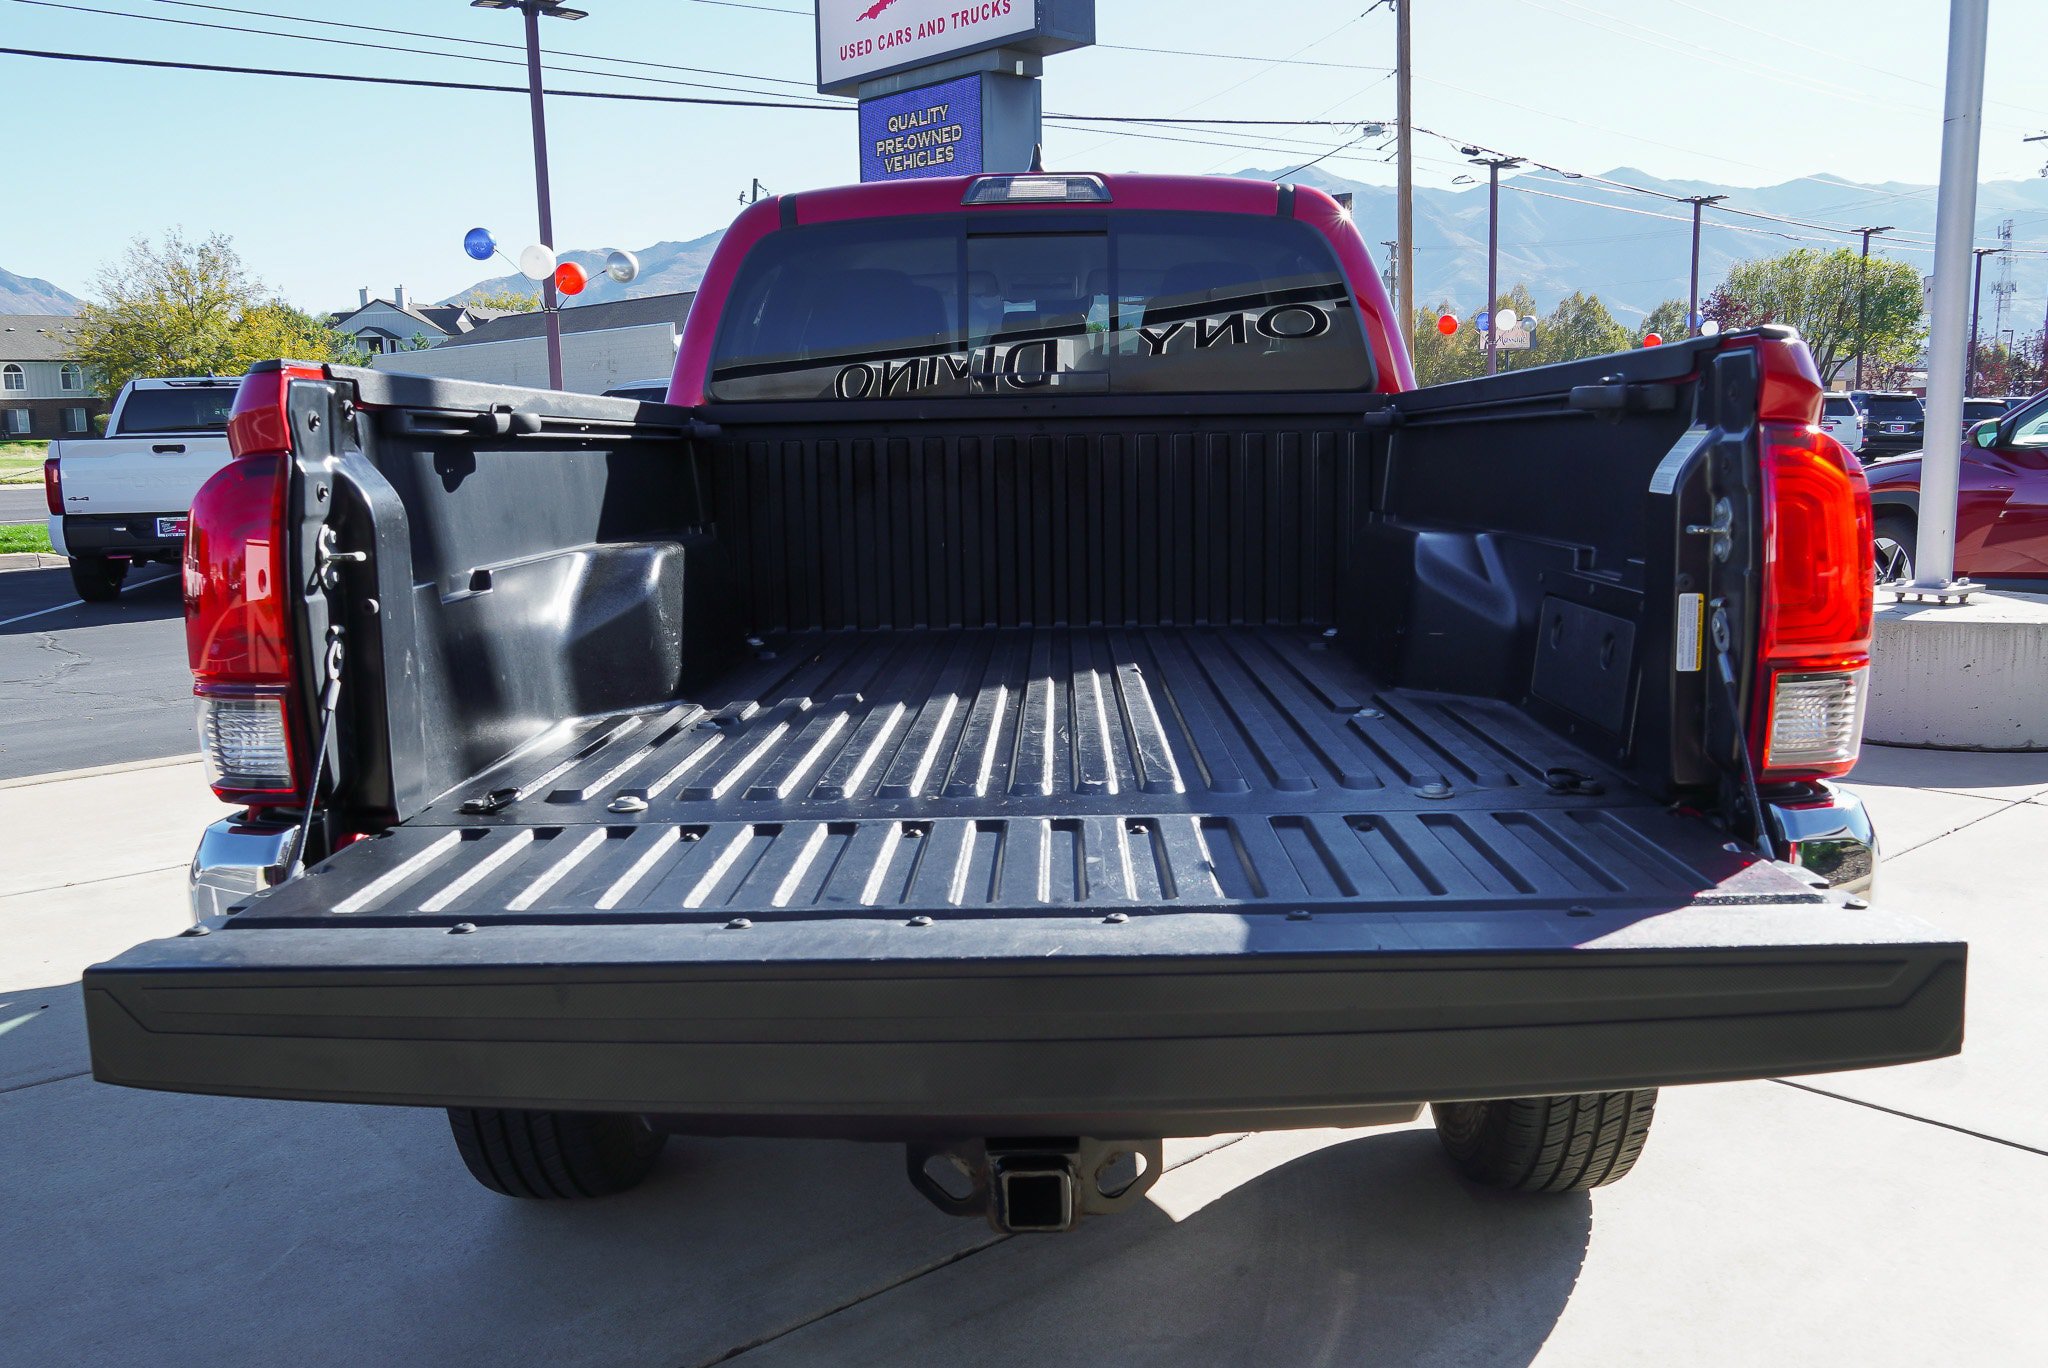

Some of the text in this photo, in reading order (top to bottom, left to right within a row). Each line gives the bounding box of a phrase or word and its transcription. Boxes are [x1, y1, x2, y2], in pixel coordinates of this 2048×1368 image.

[840, 0, 1011, 61] USED CARS AND TRUCKS
[888, 104, 949, 132] QUALITY
[876, 124, 962, 157] PRE-OWNED
[884, 145, 954, 173] VEHICLES
